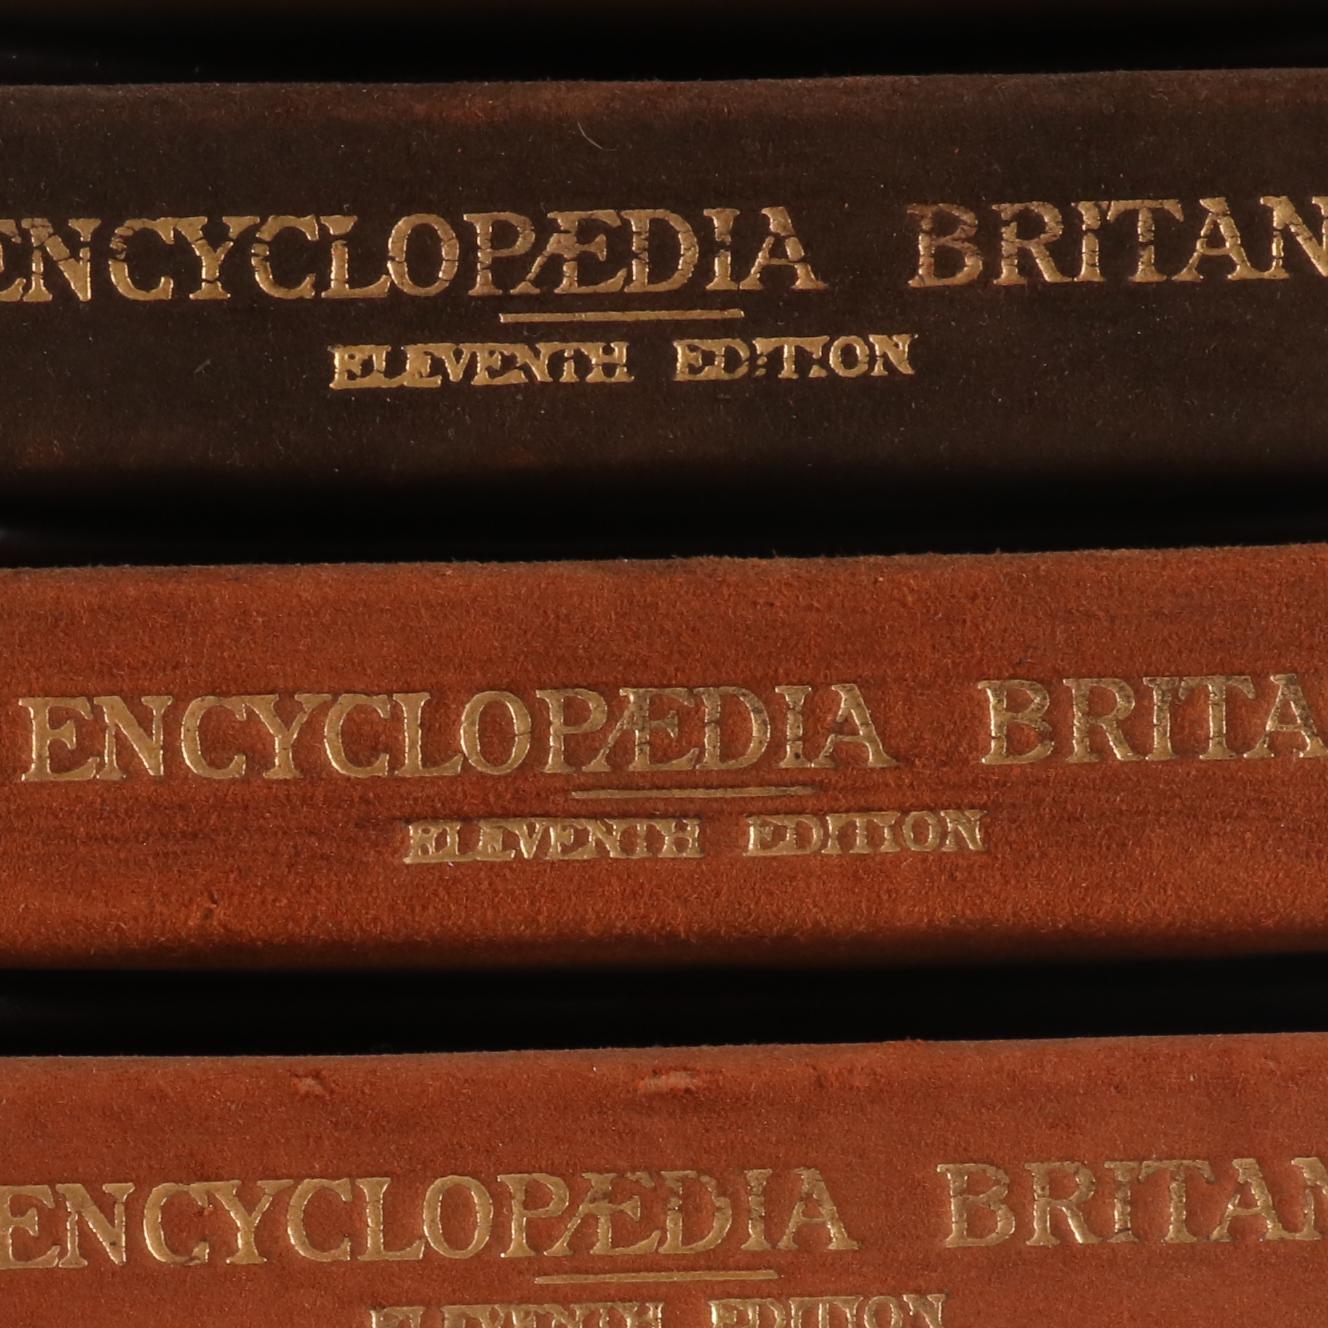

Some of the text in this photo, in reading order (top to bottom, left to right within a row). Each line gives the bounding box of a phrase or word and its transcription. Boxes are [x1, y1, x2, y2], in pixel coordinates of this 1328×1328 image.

[329, 332, 919, 390] ELEVENTH EDITION
[17, 684, 901, 783] ENCYCLOPÆDIA
[402, 810, 989, 865] ELEVENTH EDITION
